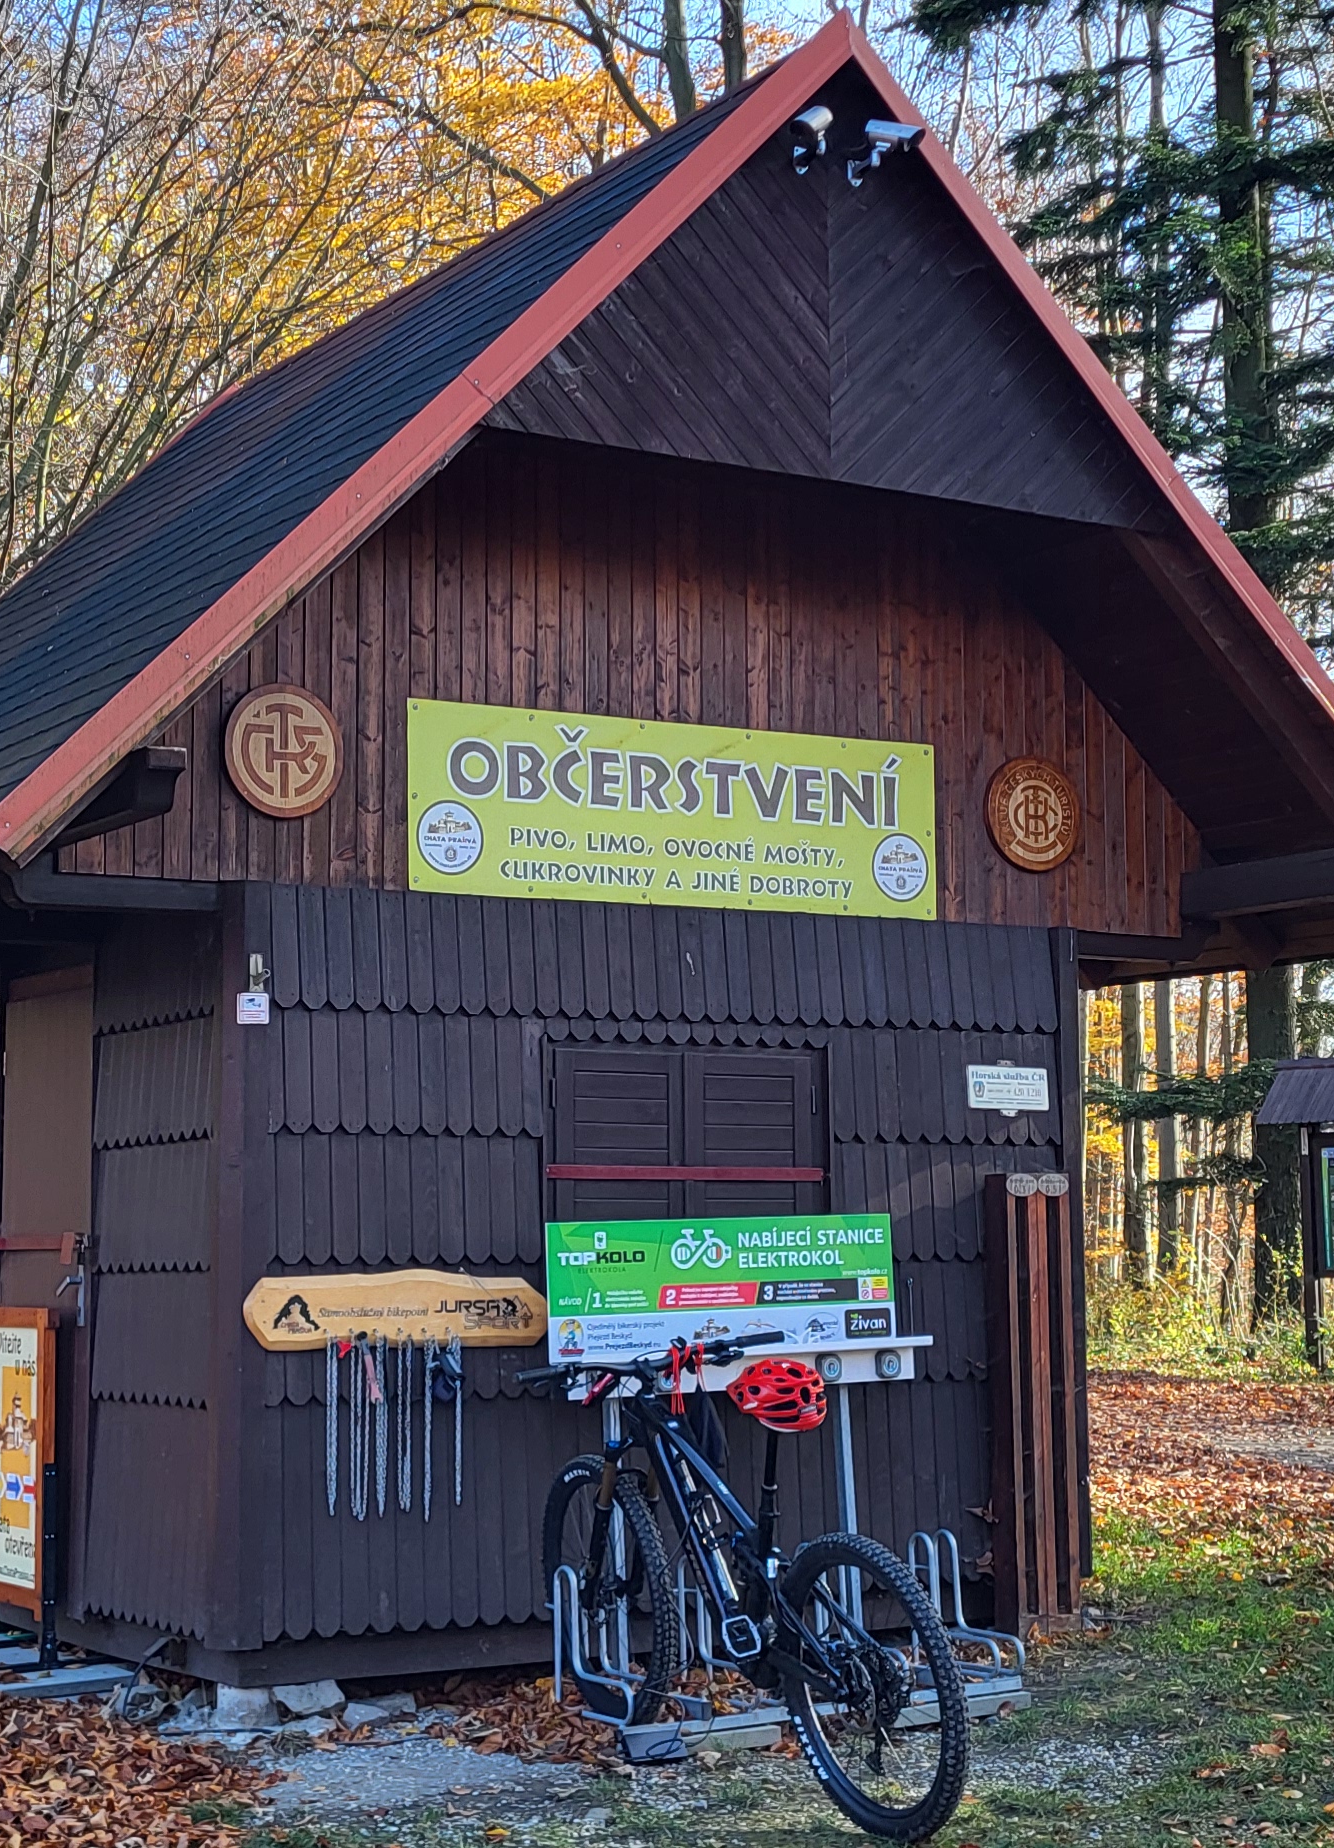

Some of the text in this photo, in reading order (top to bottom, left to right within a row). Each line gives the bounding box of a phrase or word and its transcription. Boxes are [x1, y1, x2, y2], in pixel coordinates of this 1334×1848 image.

[448, 725, 900, 829] OBČERSTVENÍ
[510, 826, 844, 869] PIVO, LIMO, OVOCNÉ MOŠTY,
[499, 859, 656, 888] CUKROVINKY
[665, 869, 683, 890] A
[691, 868, 740, 893] JINÉ
[749, 875, 853, 900] DOBROTY
[971, 1070, 1045, 1081] Horská služba ČR
[738, 1226, 885, 1248] NABÍJECÍ STANICE
[557, 1251, 645, 1266] TOPKOLO
[738, 1250, 844, 1268] ELEKTROKOL
[592, 1292, 602, 1308] 1
[665, 1289, 676, 1305] 2
[763, 1285, 774, 1300] 3
[387, 1302, 429, 1319] bikepoint
[22, 1353, 36, 1377] nás
[4, 1534, 36, 1559] otevřen
